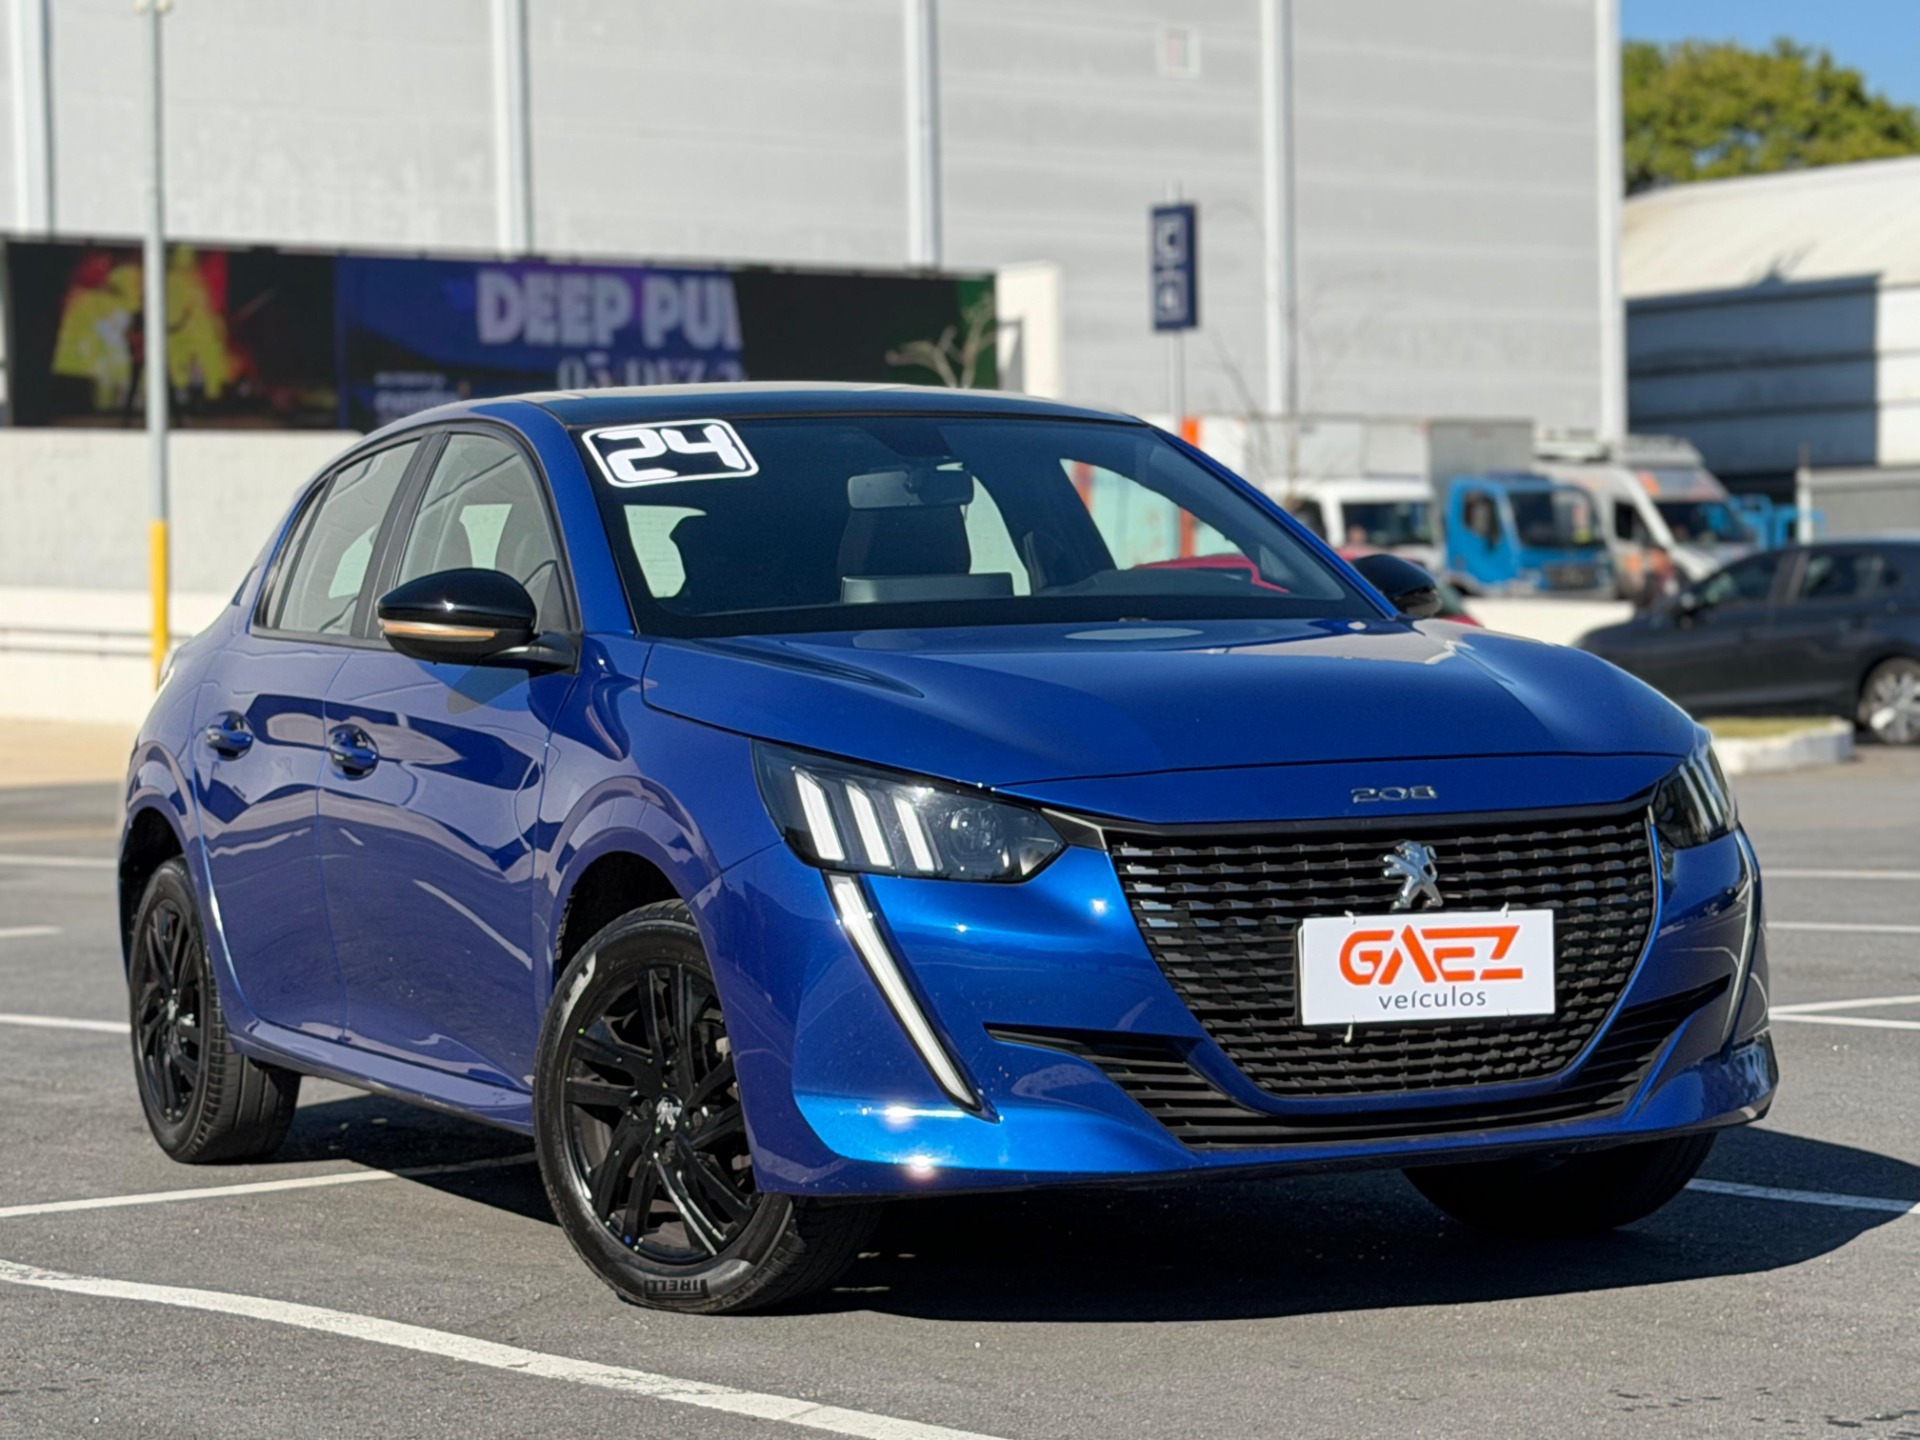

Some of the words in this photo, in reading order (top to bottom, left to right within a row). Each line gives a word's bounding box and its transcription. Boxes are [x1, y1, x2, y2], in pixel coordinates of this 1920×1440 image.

[476, 269, 633, 347] DEEP
[598, 424, 747, 482] 24
[1351, 785, 1438, 804] 208
[1339, 924, 1523, 986] GAEZ
[1378, 985, 1486, 1010] veículos
